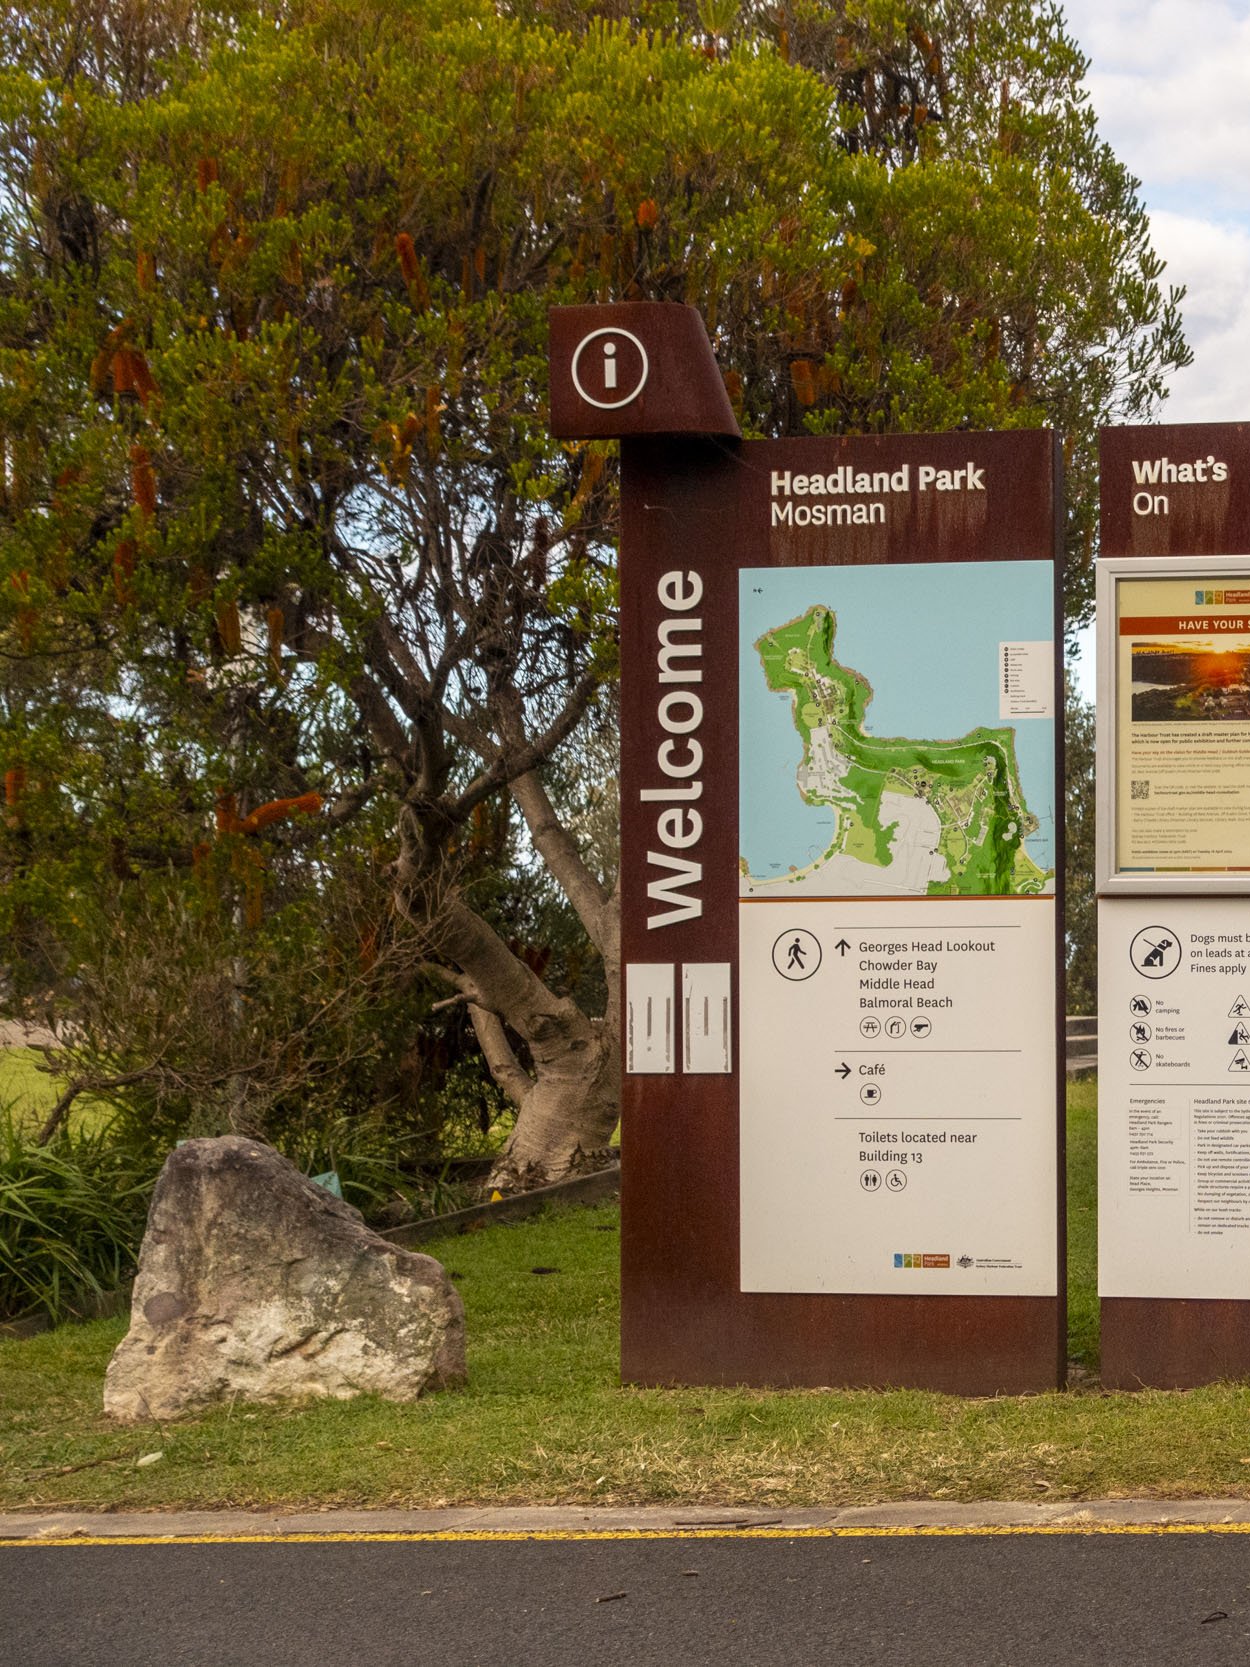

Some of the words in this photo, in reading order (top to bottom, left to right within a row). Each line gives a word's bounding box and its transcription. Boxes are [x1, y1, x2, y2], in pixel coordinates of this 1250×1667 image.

[1132, 456, 1228, 484] What's
[771, 464, 909, 496] Headland
[919, 462, 985, 491] Park
[1133, 492, 1169, 515] On
[772, 501, 885, 526] Mosman
[1179, 620, 1208, 630] HAVE
[1213, 620, 1243, 629] YOUR
[640, 570, 703, 930] Welcome
[1190, 934, 1215, 945] Dogs
[1218, 934, 1243, 942] must
[859, 942, 908, 955] Georges
[912, 940, 942, 952] Head
[947, 940, 995, 952] Lookout
[1190, 950, 1202, 958] on
[1206, 948, 1232, 958] leads
[1235, 950, 1245, 958] at
[859, 960, 913, 971] Chowder
[917, 960, 938, 973] Bay
[1191, 963, 1216, 973] Fines
[1219, 963, 1246, 975] apply
[860, 978, 900, 989] Middle
[904, 978, 934, 989] Head
[860, 996, 913, 1008] Balmoral
[917, 996, 952, 1008] Beach
[859, 1064, 885, 1075] Café
[858, 1131, 898, 1143] Toilets
[902, 1131, 946, 1143] located
[950, 1134, 977, 1143] near
[860, 1150, 908, 1165] Building
[911, 1153, 922, 1164] 13
